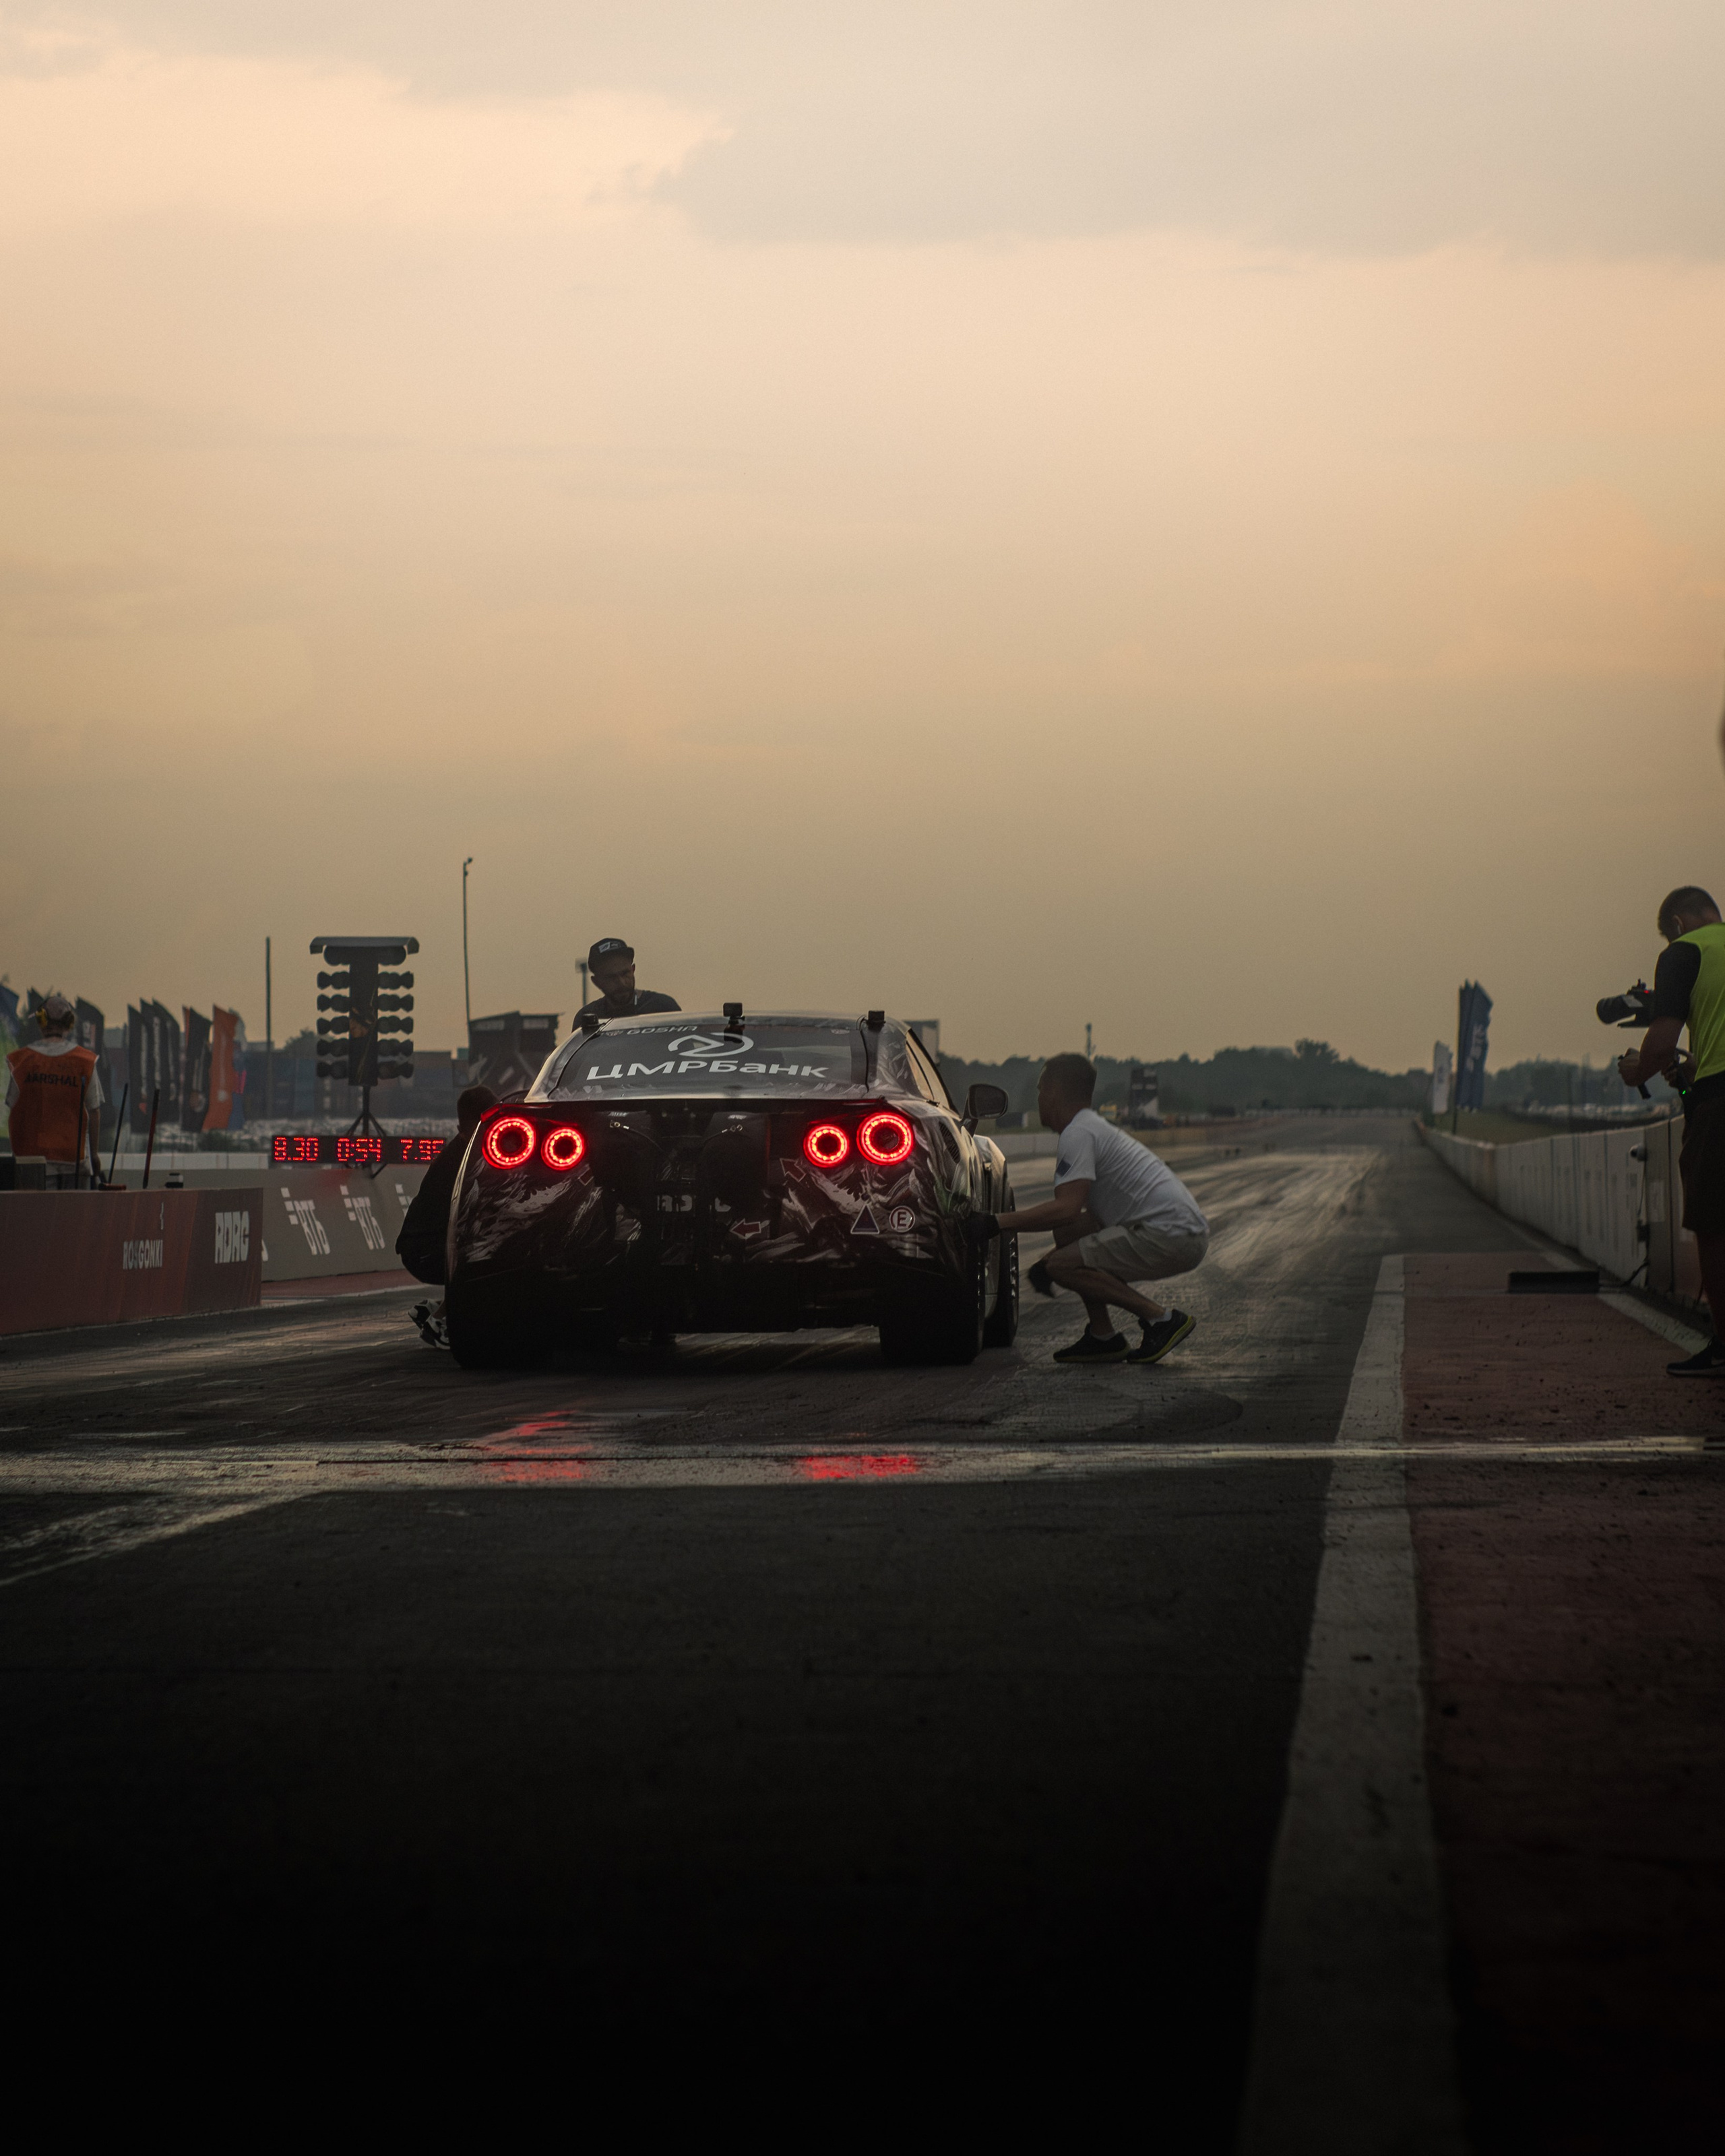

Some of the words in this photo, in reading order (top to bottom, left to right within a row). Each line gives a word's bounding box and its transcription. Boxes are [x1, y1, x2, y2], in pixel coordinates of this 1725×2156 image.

[586, 1060, 829, 1081] ЦМРБанк
[274, 1137, 318, 1161] 8.30
[337, 1138, 381, 1162] 0:54
[897, 1211, 907, 1227] E
[215, 1211, 249, 1264] RDRC
